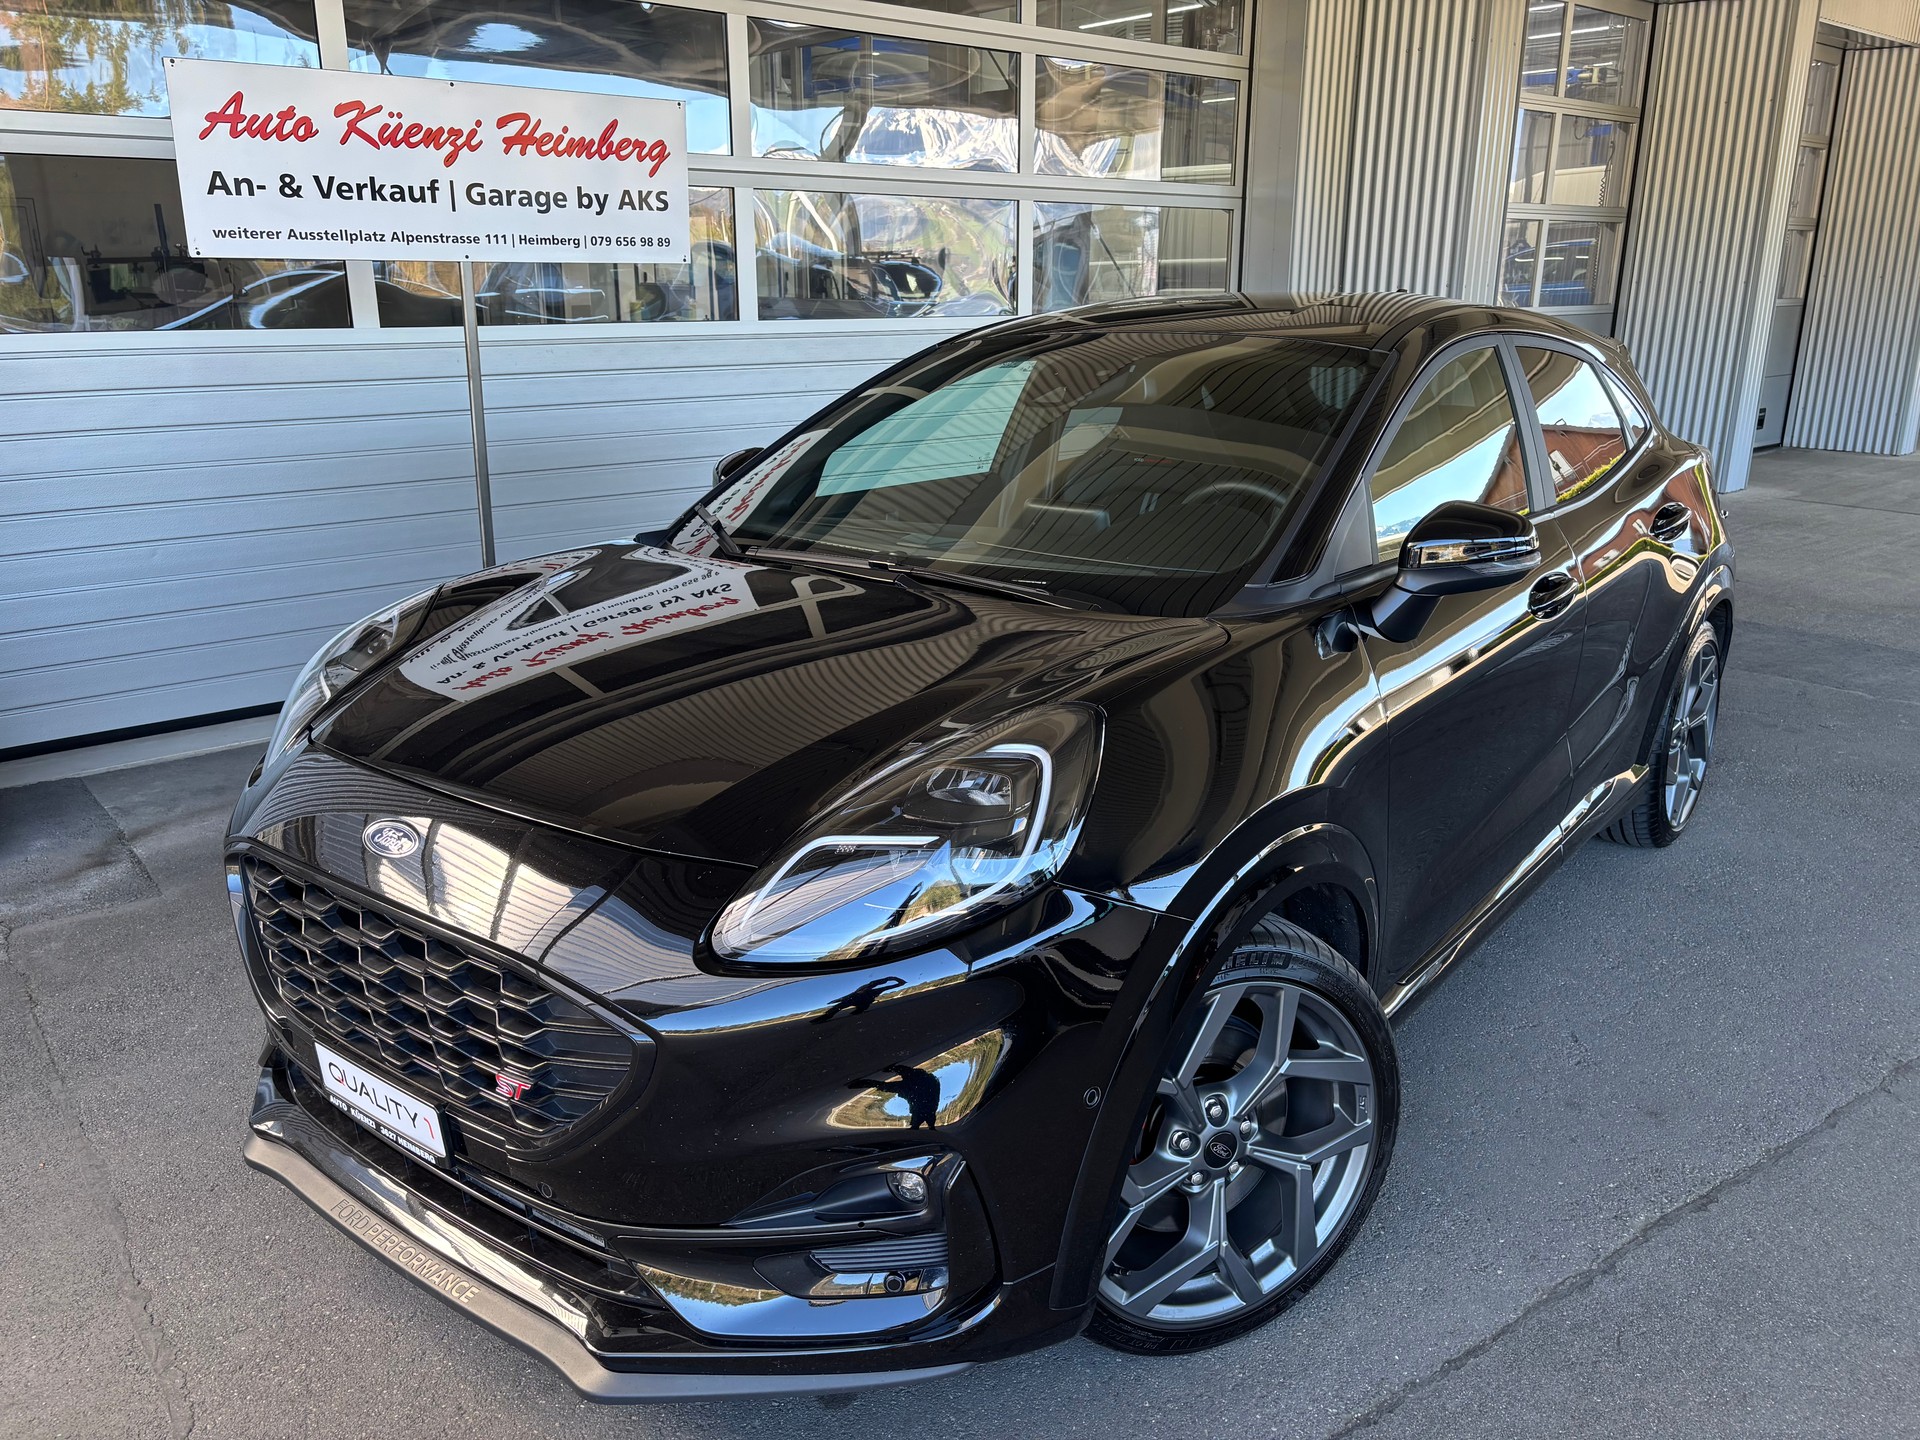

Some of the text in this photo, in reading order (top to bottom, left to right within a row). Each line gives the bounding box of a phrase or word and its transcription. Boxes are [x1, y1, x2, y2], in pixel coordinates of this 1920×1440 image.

[199, 91, 672, 178] Auto Küenzi Heimberg
[207, 171, 267, 197] An-
[279, 173, 304, 199] &
[312, 175, 440, 204] Verkauf
[465, 182, 568, 214] Garage
[577, 186, 610, 216] by
[618, 189, 669, 212] AKS
[212, 227, 282, 240] weiterer
[287, 229, 386, 244] Ausstellplatz
[390, 231, 480, 246] Alpenstrasse
[484, 233, 507, 245] 111
[518, 235, 581, 249] Heimberg
[590, 236, 612, 247] 079
[615, 236, 637, 247] 656
[640, 237, 654, 248] 98
[657, 237, 671, 248] 89
[495, 1073, 532, 1100] ST
[330, 1095, 348, 1111] AUTO
[350, 1107, 376, 1129] KÜENZI
[397, 1136, 437, 1164] HEIMBERG
[330, 1199, 371, 1230] FORD
[362, 1222, 481, 1304] PERFORMANCE
